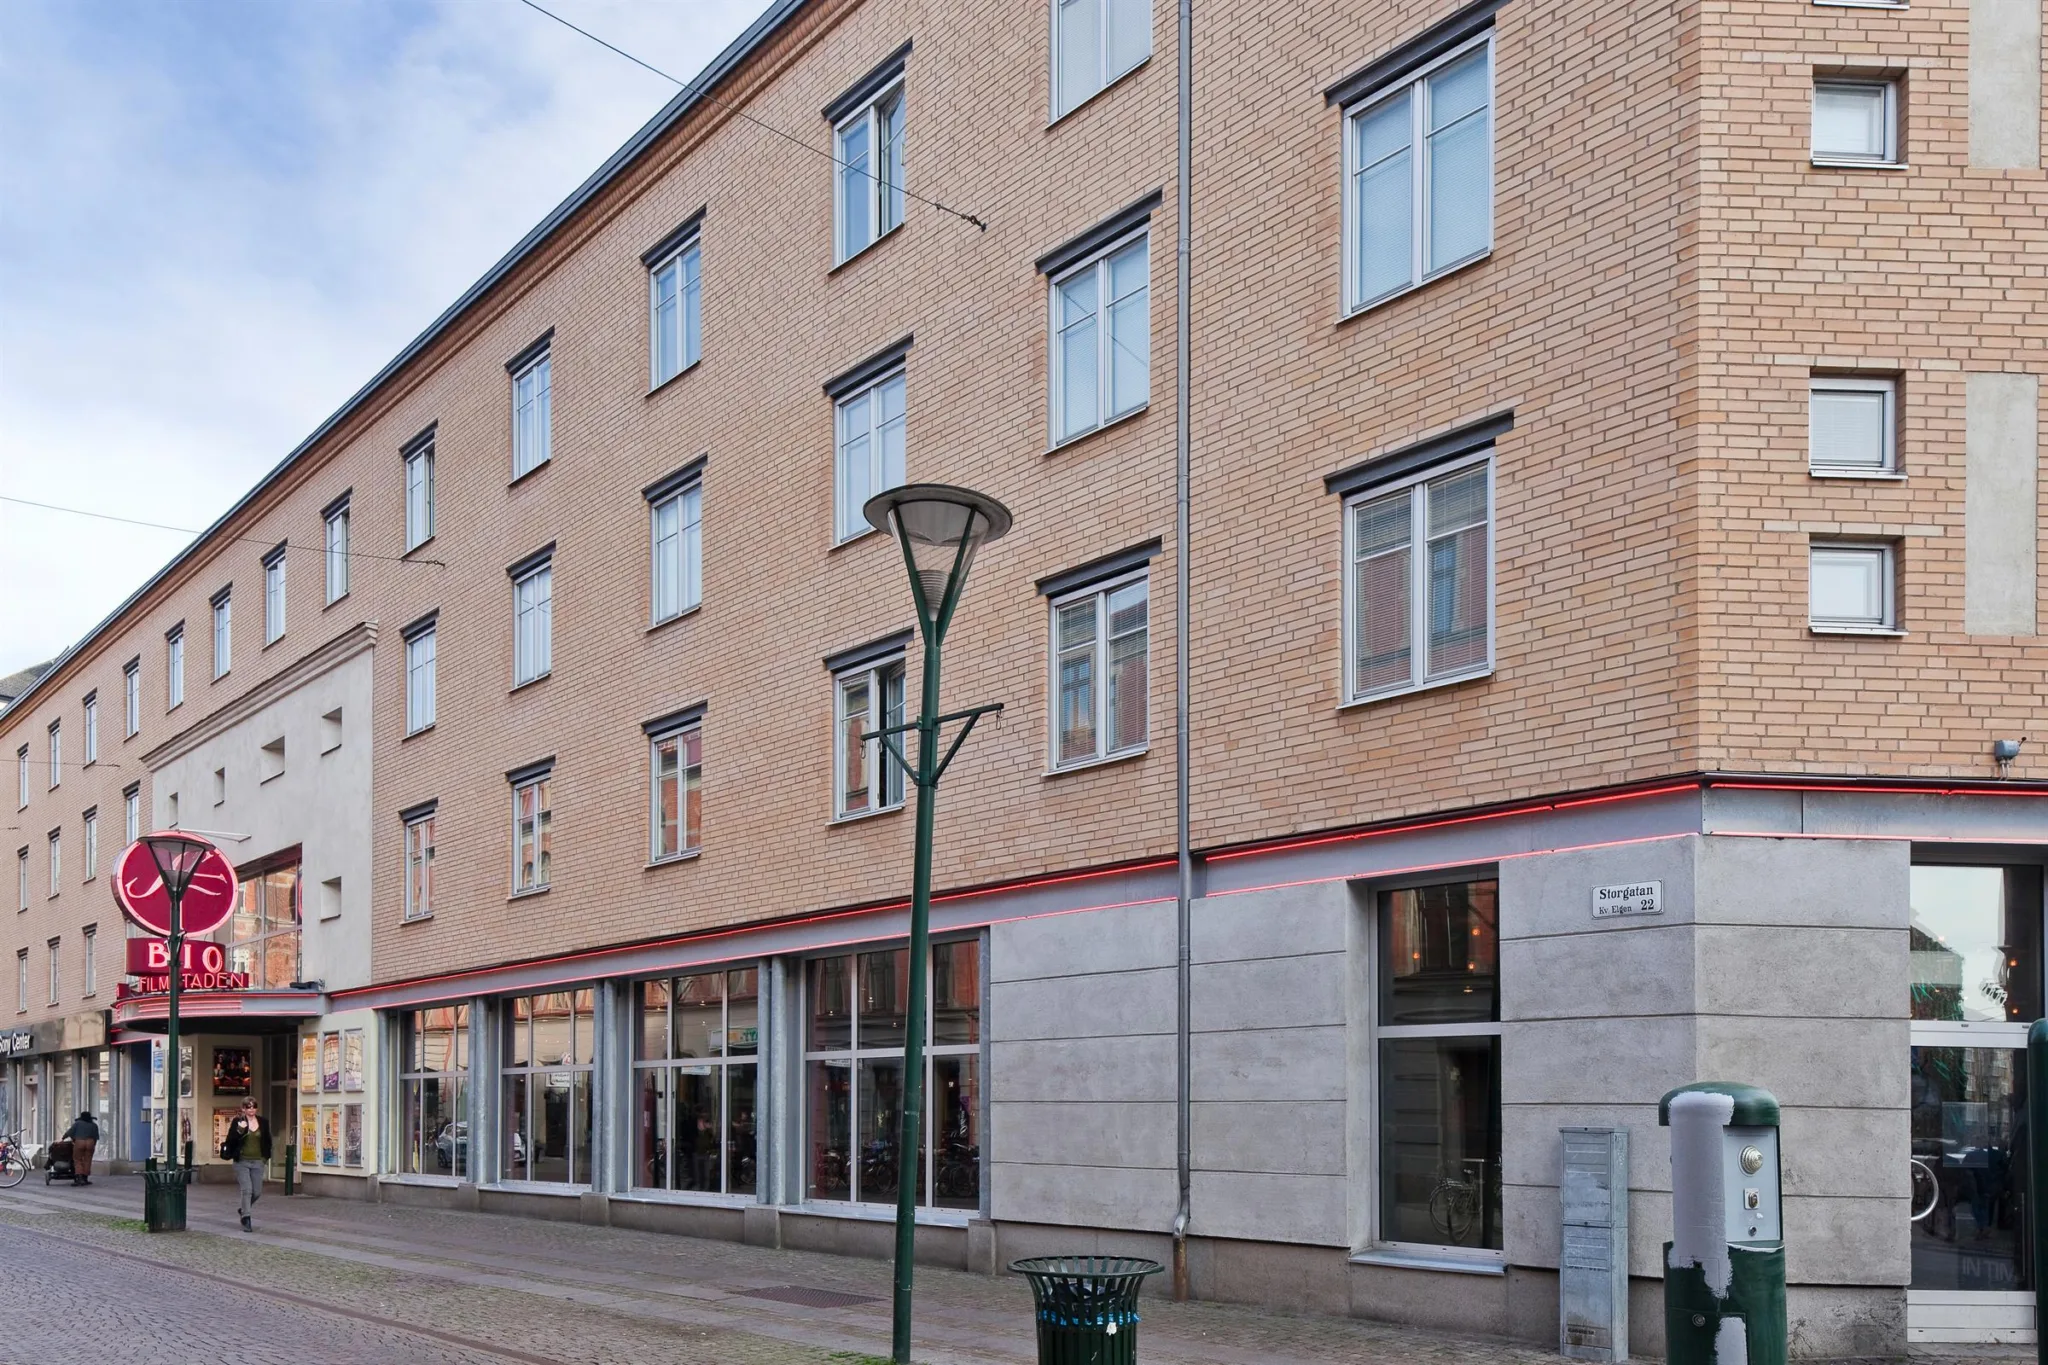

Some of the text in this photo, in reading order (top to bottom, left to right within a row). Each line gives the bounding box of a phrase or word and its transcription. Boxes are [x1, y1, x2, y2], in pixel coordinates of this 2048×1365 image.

[1599, 886, 1653, 901] Storgatan
[1611, 905, 1632, 914] Elgen
[1640, 899, 1654, 911] 22
[147, 942, 223, 974] BIO
[139, 972, 244, 992] FILMTADEN
[12, 1032, 30, 1051] Center
